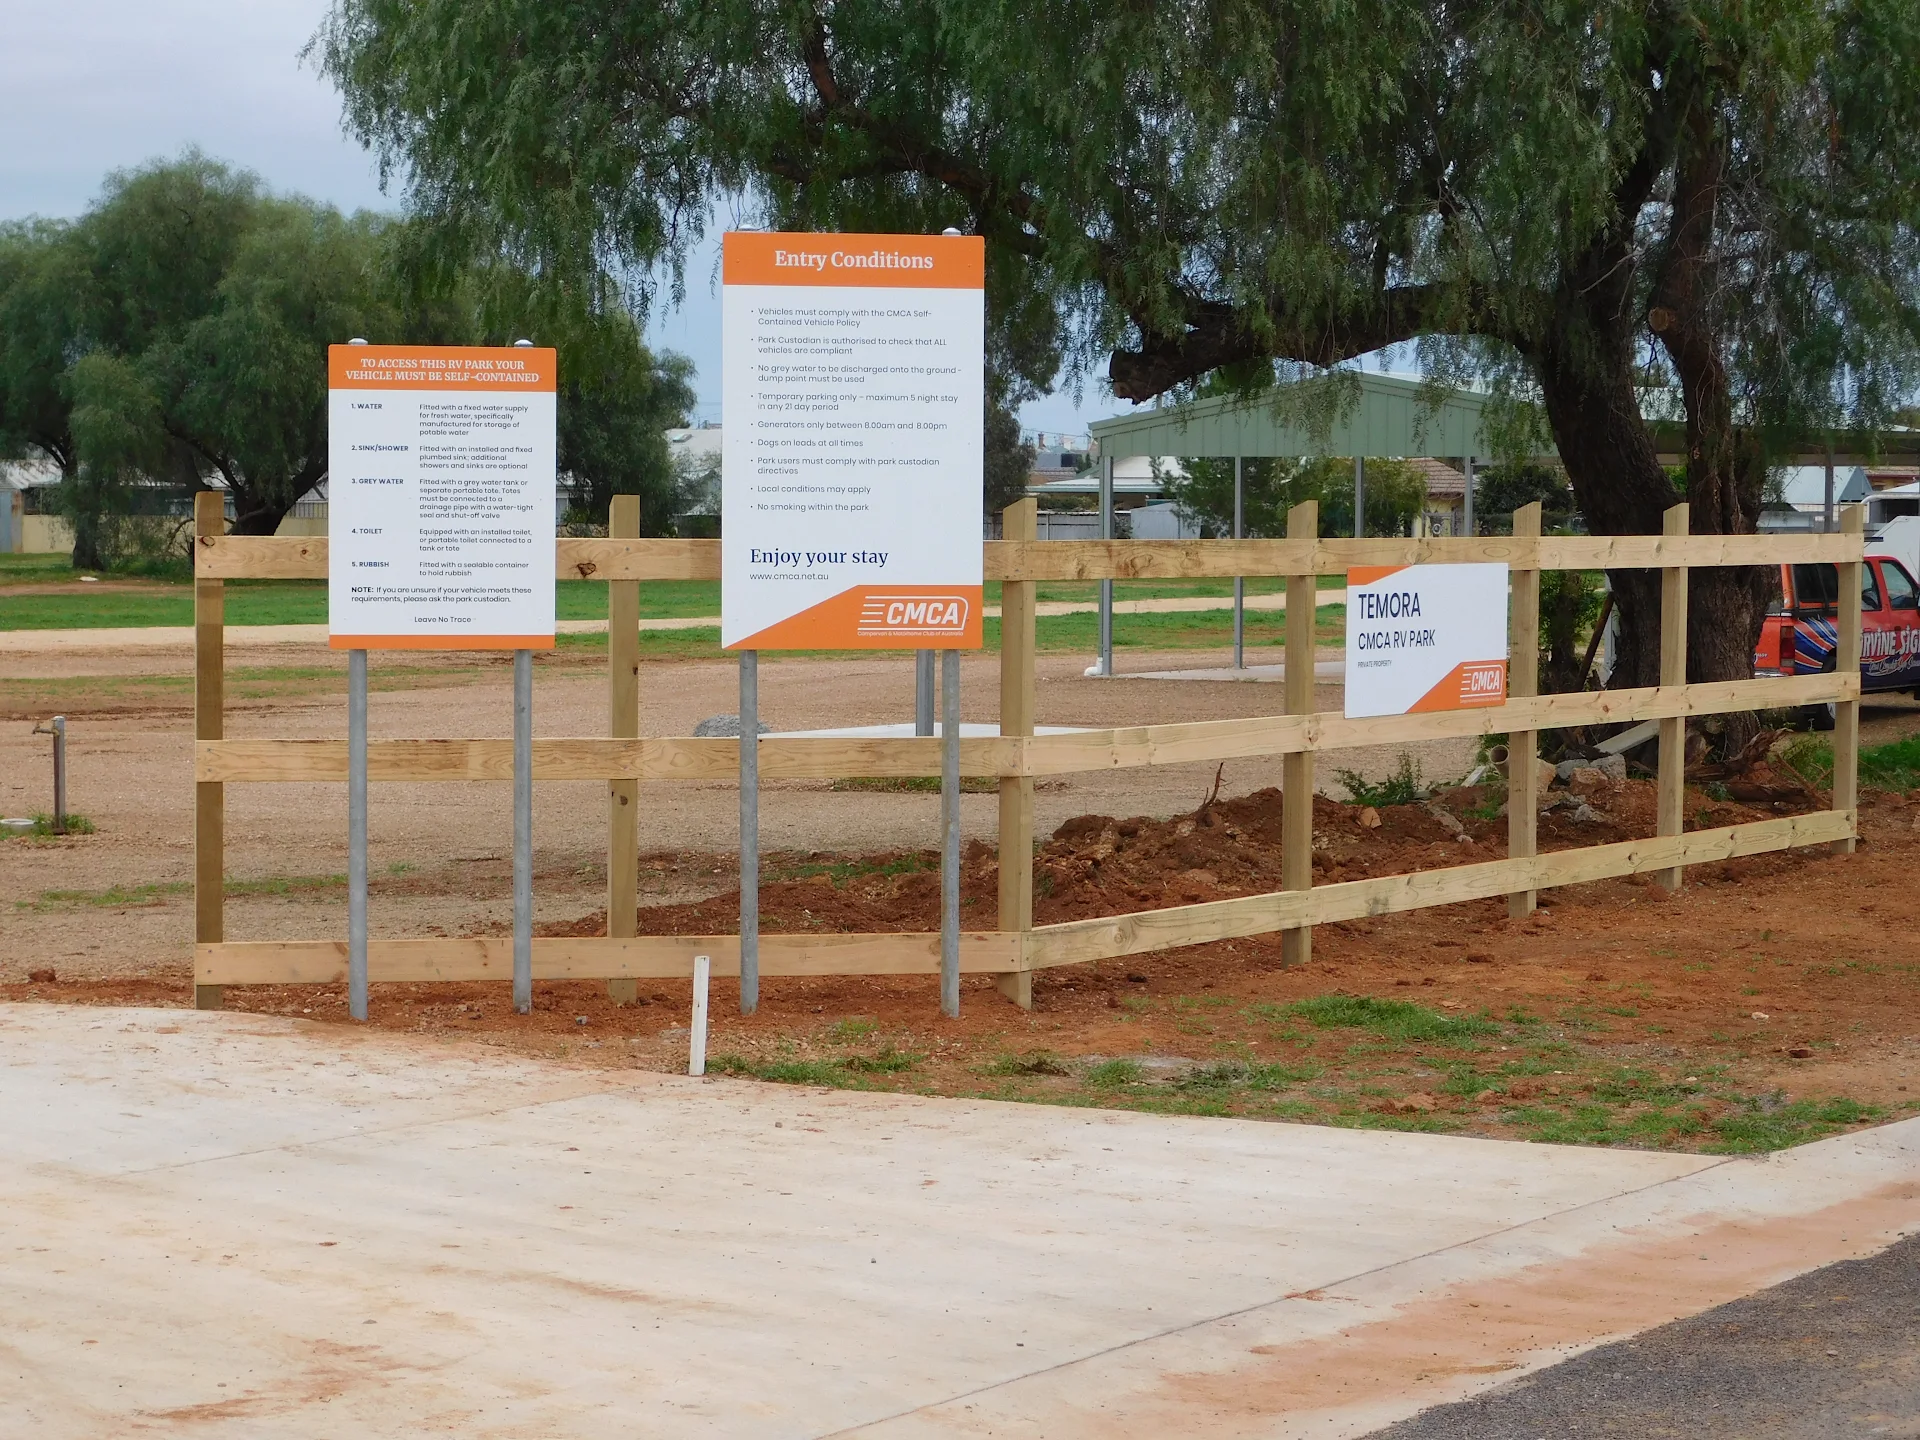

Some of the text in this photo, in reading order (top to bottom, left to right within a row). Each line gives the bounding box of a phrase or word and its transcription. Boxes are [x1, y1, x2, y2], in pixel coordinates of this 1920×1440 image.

[775, 250, 934, 272] Entry Conditions
[758, 308, 793, 316] Vehicles
[818, 309, 850, 318] comply
[852, 309, 869, 317] with
[871, 309, 885, 317] the
[758, 318, 802, 326] Contained
[837, 318, 860, 328] Policy
[758, 336, 776, 344] Park
[778, 336, 821, 344] Custodian
[831, 337, 876, 345] authorised
[915, 338, 932, 346] that
[758, 346, 792, 354] vehicles
[810, 346, 852, 356] compliant
[361, 358, 525, 370] TO ACCESS THIS RV PARK YOUR
[771, 366, 790, 374] grey
[828, 365, 839, 373] be
[841, 365, 888, 375] discharged
[926, 367, 956, 376] ground
[346, 370, 540, 382] VEHICLE MUST BE SELF-CONTAINED
[758, 374, 783, 384] dump
[785, 375, 806, 383] point
[832, 375, 842, 383] be
[758, 393, 804, 402] Temporary
[806, 393, 837, 403] parking
[839, 394, 857, 403] only
[866, 393, 909, 401] maximum
[918, 394, 938, 404] night
[941, 395, 958, 404] stay
[505, 406, 528, 414] supply
[767, 404, 783, 412] any
[794, 403, 810, 412] day
[812, 402, 839, 412] period
[474, 413, 514, 421] specifically
[807, 421, 825, 430] only
[917, 422, 947, 431] 8.00pm
[420, 429, 447, 437] potable
[359, 444, 409, 452] SINK/SHOWER
[758, 439, 779, 448] Dogs
[794, 439, 816, 447] leads
[840, 439, 863, 447] times
[825, 458, 857, 467] comply
[858, 457, 876, 465] with
[878, 458, 896, 467] park
[758, 467, 798, 475] directives
[781, 485, 825, 493] conditions
[827, 487, 846, 495] may
[848, 486, 871, 495] apply
[771, 503, 806, 513] smoking
[851, 504, 869, 513] park
[751, 548, 889, 568] Enjoy your stay
[352, 595, 402, 604] requirements,
[404, 596, 428, 604] please
[456, 596, 472, 604] park
[1358, 593, 1421, 619] TEMORA
[885, 602, 958, 625] CMCA
[1358, 629, 1435, 650] CMCA RV PARK
[1899, 625, 1920, 654] SIG
[1471, 670, 1500, 691] CMCA
